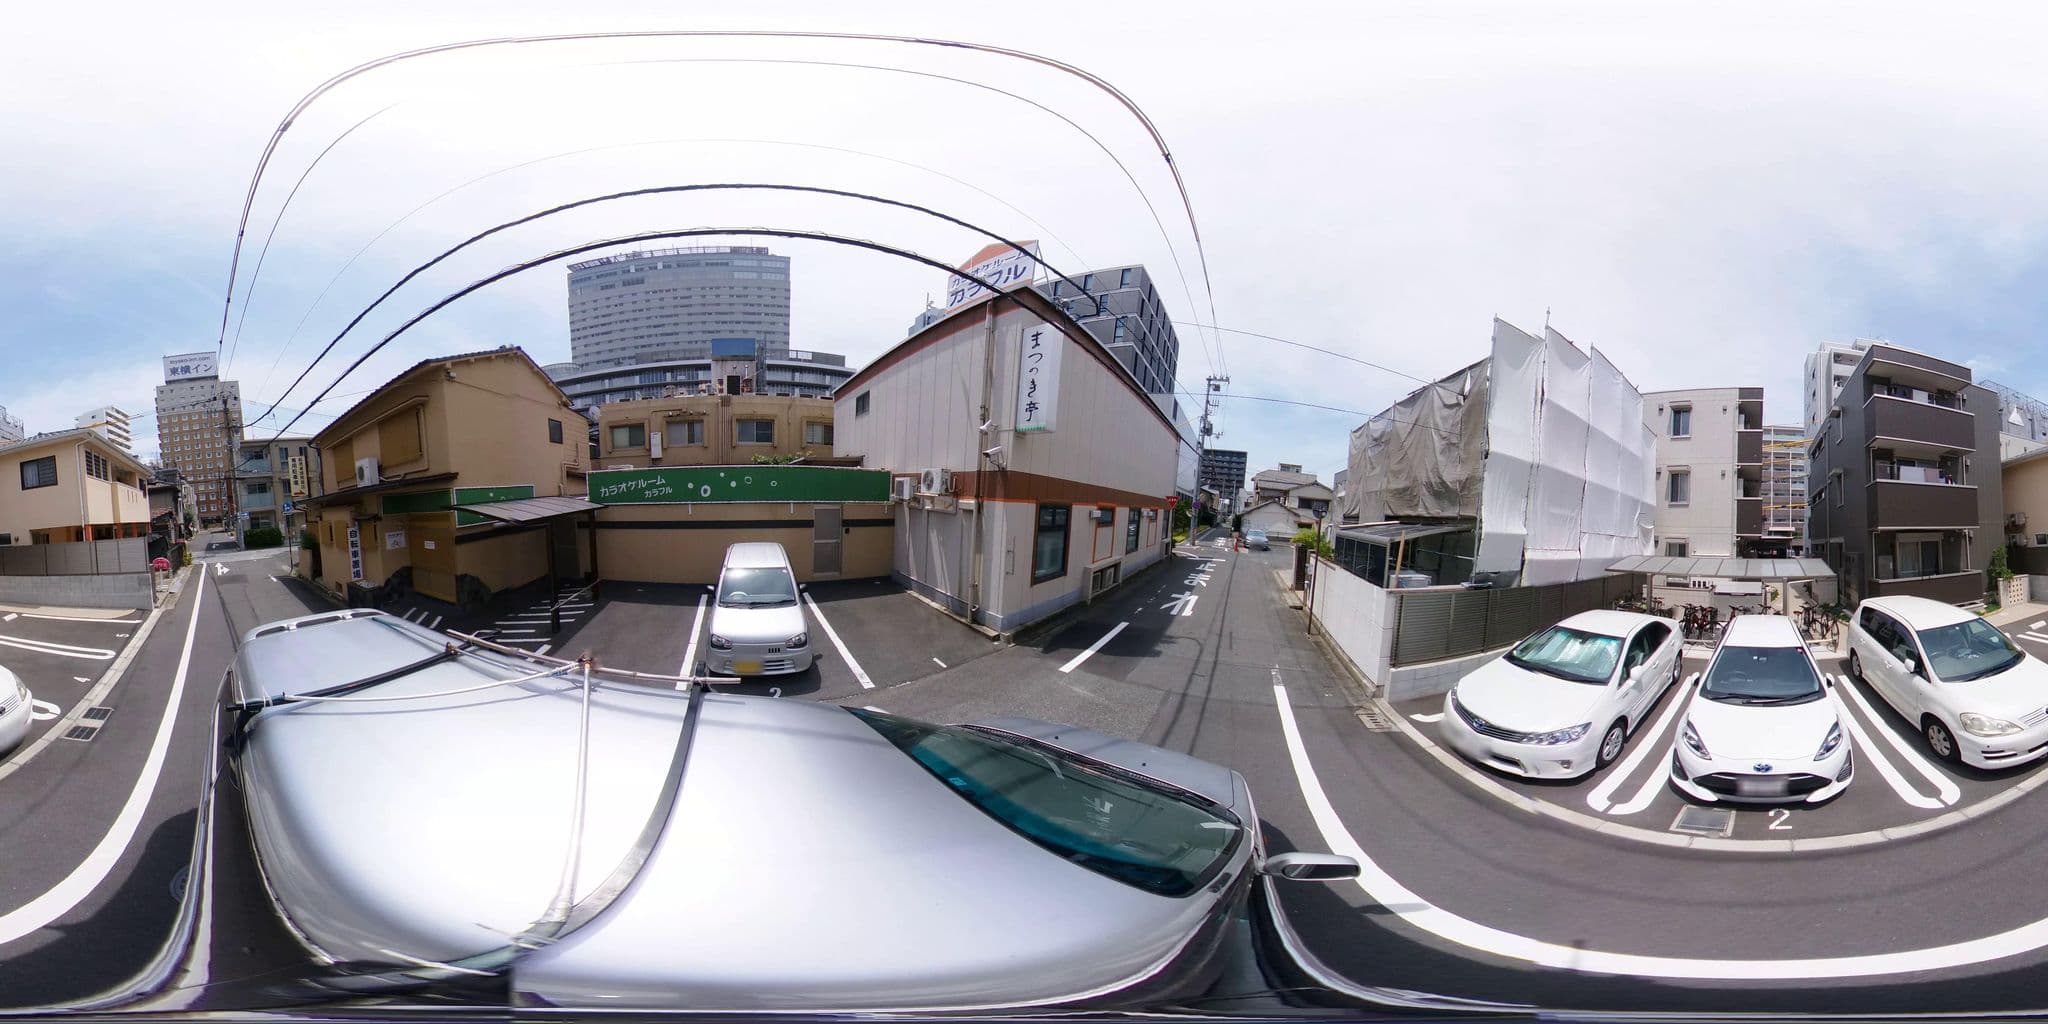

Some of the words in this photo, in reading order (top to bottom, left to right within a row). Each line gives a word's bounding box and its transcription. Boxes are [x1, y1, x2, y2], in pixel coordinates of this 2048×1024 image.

[170, 364, 212, 376] 東横イン
[1025, 331, 1043, 421] まつのき亭
[600, 475, 666, 497] カラオケルーム
[644, 486, 673, 498] カラフル
[349, 530, 362, 579] 自転車置場
[1768, 808, 1793, 830] 2
